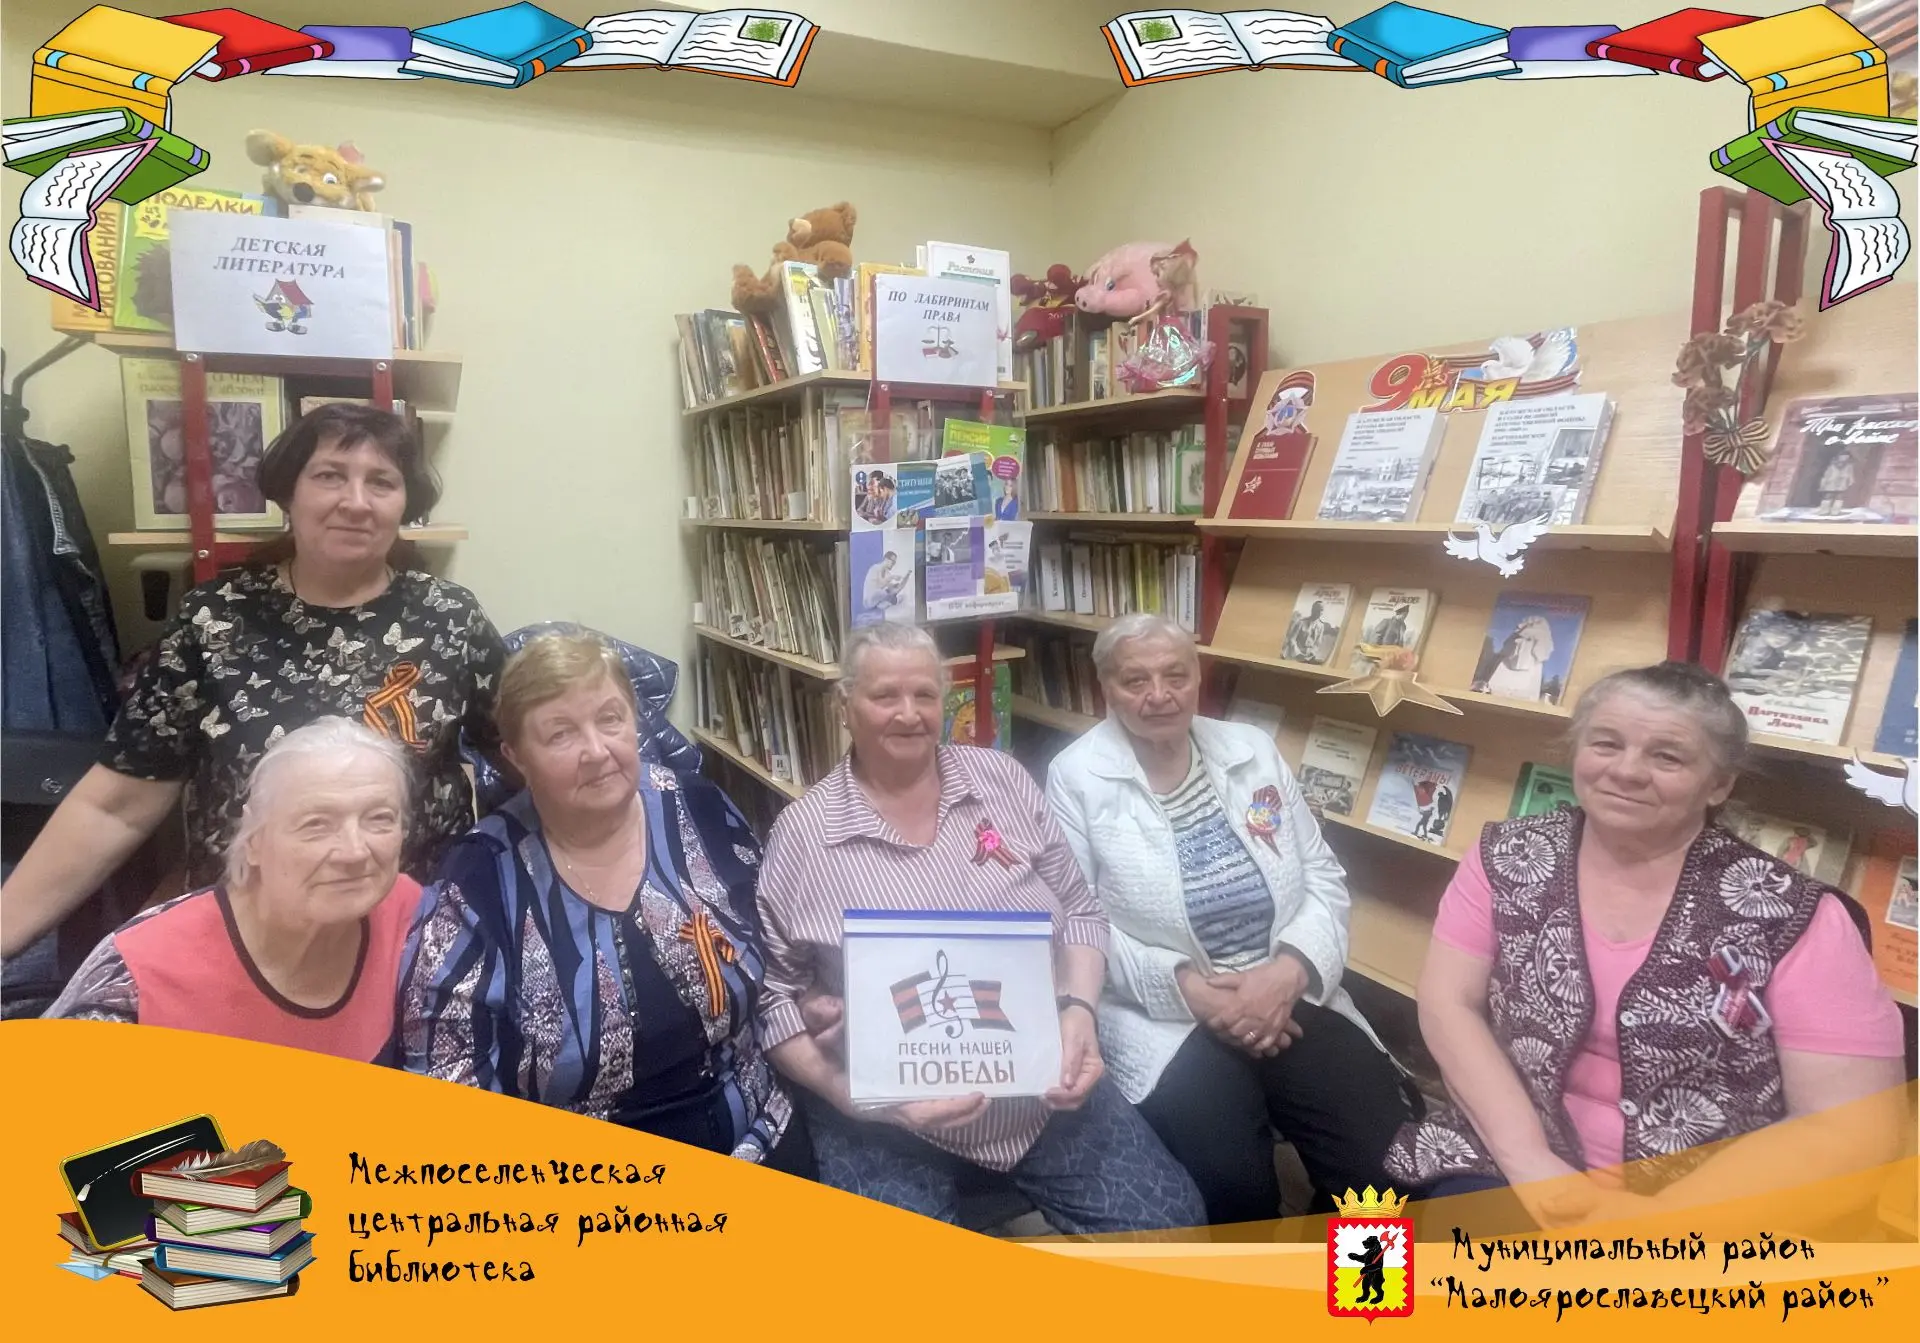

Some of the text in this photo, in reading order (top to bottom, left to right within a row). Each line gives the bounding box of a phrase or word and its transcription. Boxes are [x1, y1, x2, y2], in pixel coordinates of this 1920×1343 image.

[231, 236, 326, 257] ДЕТСКАЯ
[213, 256, 345, 279] ЛИТЕРАТУРА
[888, 290, 989, 312] ПО ЛАБИРИНТАМ
[922, 309, 961, 323] ПРАВА
[1361, 353, 1521, 413] 9 МАЯ
[1800, 416, 1845, 436] Три
[1395, 761, 1451, 785] ВЕТЕРАНЫ
[898, 1040, 1013, 1056] ПЕСНИ НАШЕЙ
[899, 1060, 1016, 1085] ПОБЕДЫ
